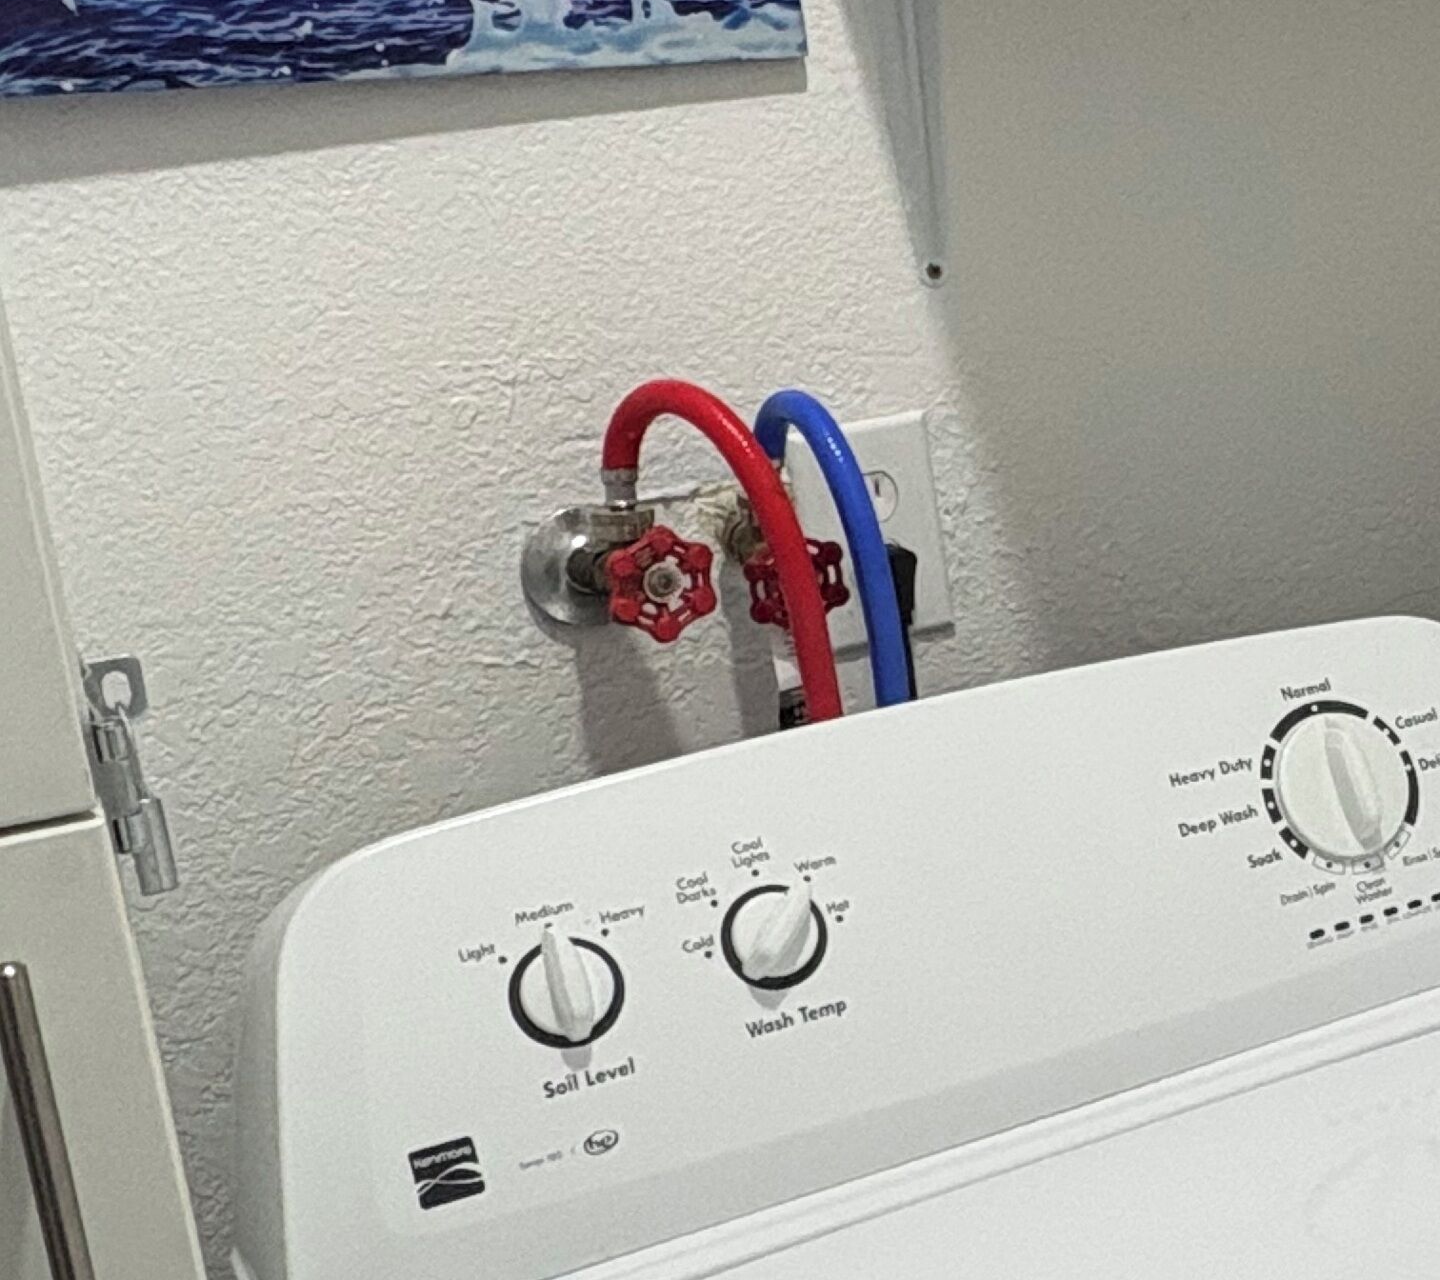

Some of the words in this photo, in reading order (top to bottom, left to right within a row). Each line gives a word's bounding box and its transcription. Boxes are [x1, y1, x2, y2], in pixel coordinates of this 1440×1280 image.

[1280, 678, 1331, 701] Normal
[1394, 708, 1438, 730] Casual
[1169, 767, 1216, 788] Heavy
[1219, 756, 1252, 779] Duty
[1178, 818, 1217, 839] Deep
[1221, 805, 1259, 826] Wash
[732, 836, 764, 856] Cool
[794, 854, 837, 873] Warm
[1247, 847, 1283, 870] Soak
[676, 871, 709, 891] Cool
[675, 886, 716, 904] Darks
[515, 900, 574, 926] Medium
[600, 905, 645, 923] Heavy
[827, 899, 850, 915] Hot
[458, 943, 497, 964] Light
[682, 935, 715, 955] Cold
[746, 1015, 795, 1039] Wash
[799, 998, 848, 1026] Temp
[543, 1073, 580, 1099] Soil
[585, 1056, 637, 1088] Level
